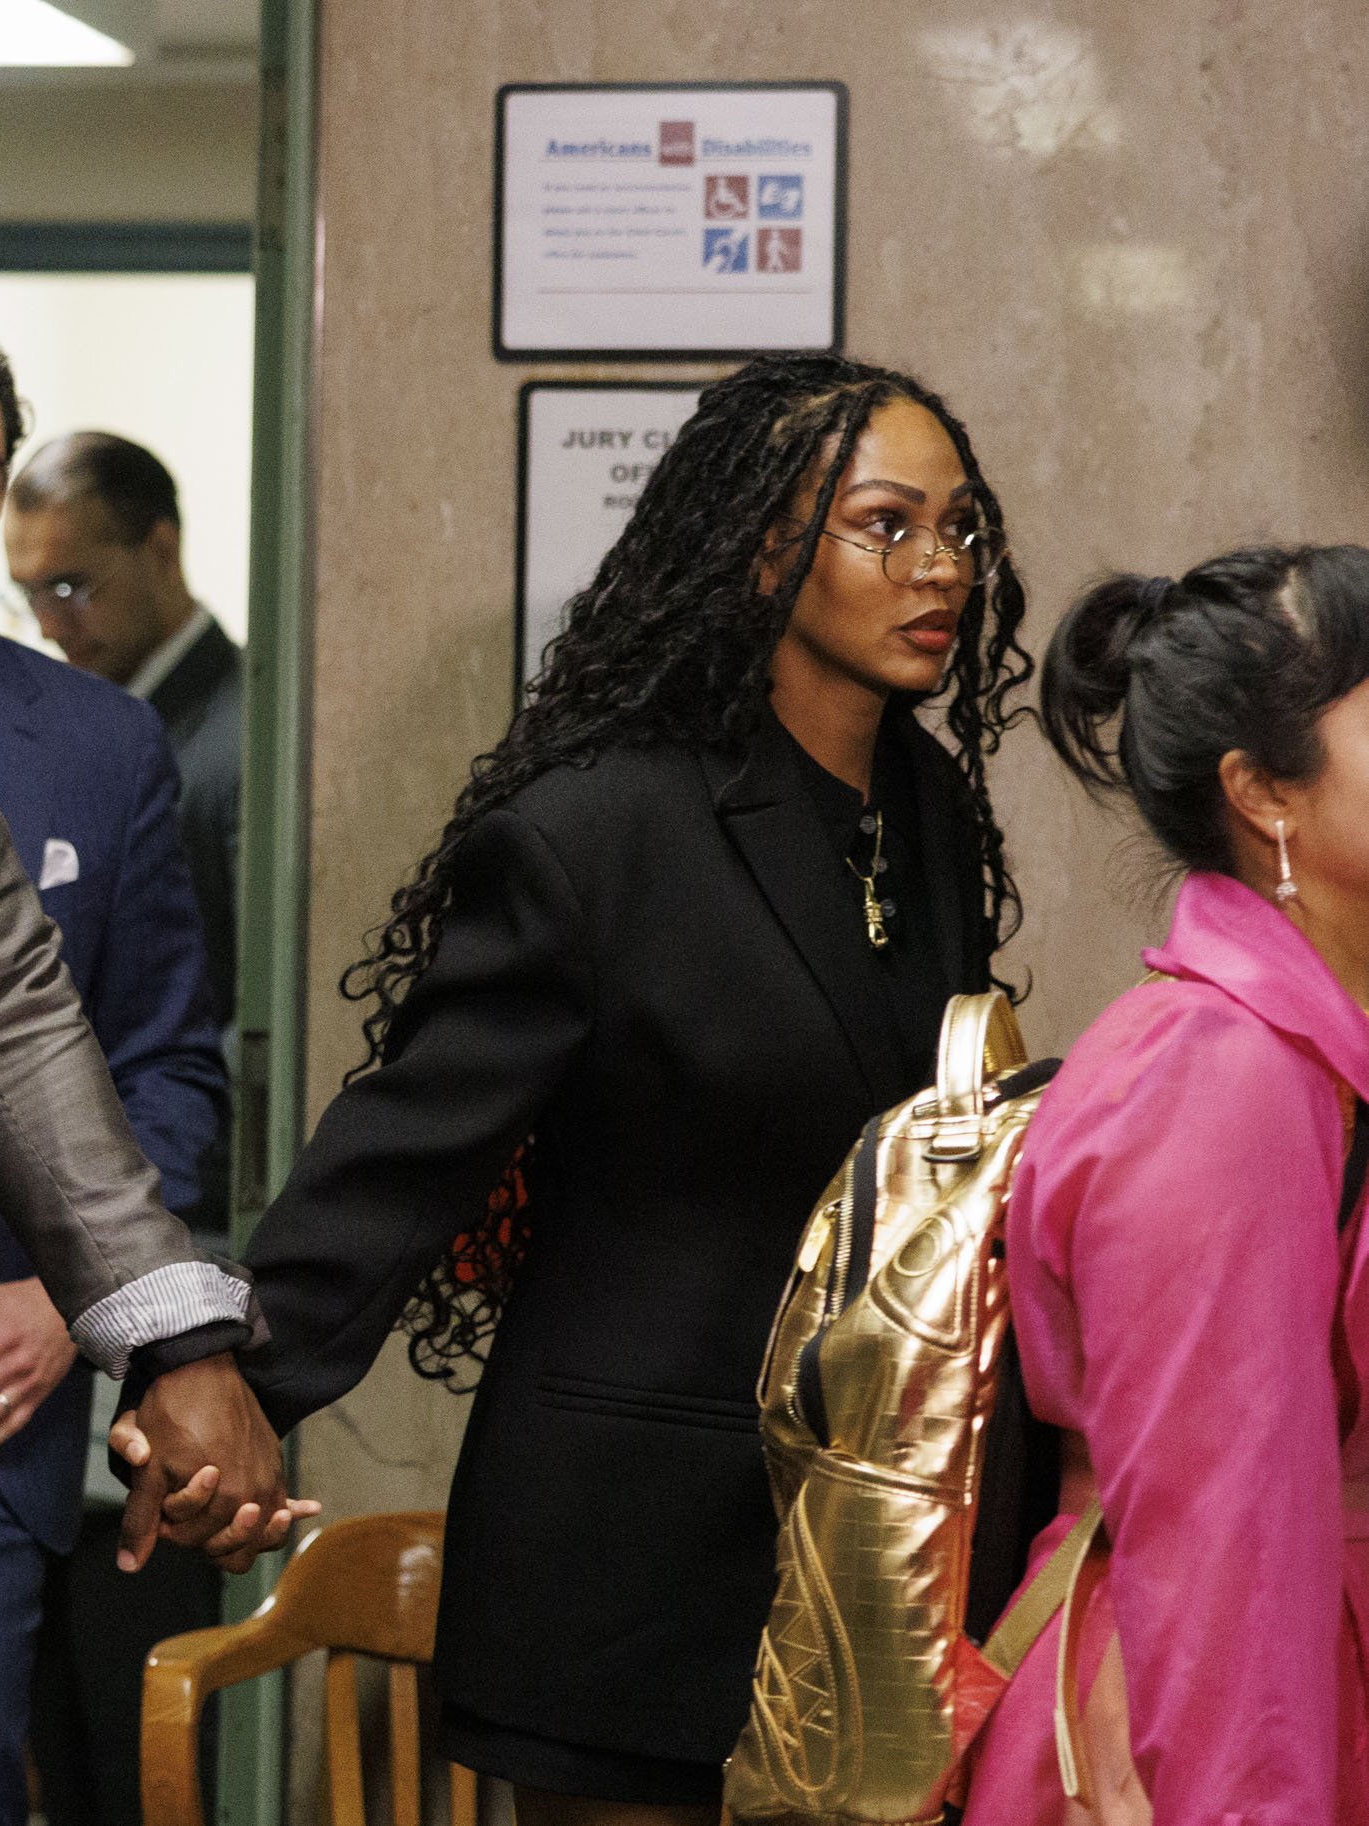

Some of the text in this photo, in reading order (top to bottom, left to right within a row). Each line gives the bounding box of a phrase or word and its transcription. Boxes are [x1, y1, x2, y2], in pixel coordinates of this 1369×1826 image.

[546, 138, 651, 157] Americans
[702, 138, 812, 157] Disabilities
[562, 430, 674, 449] JURY CL
